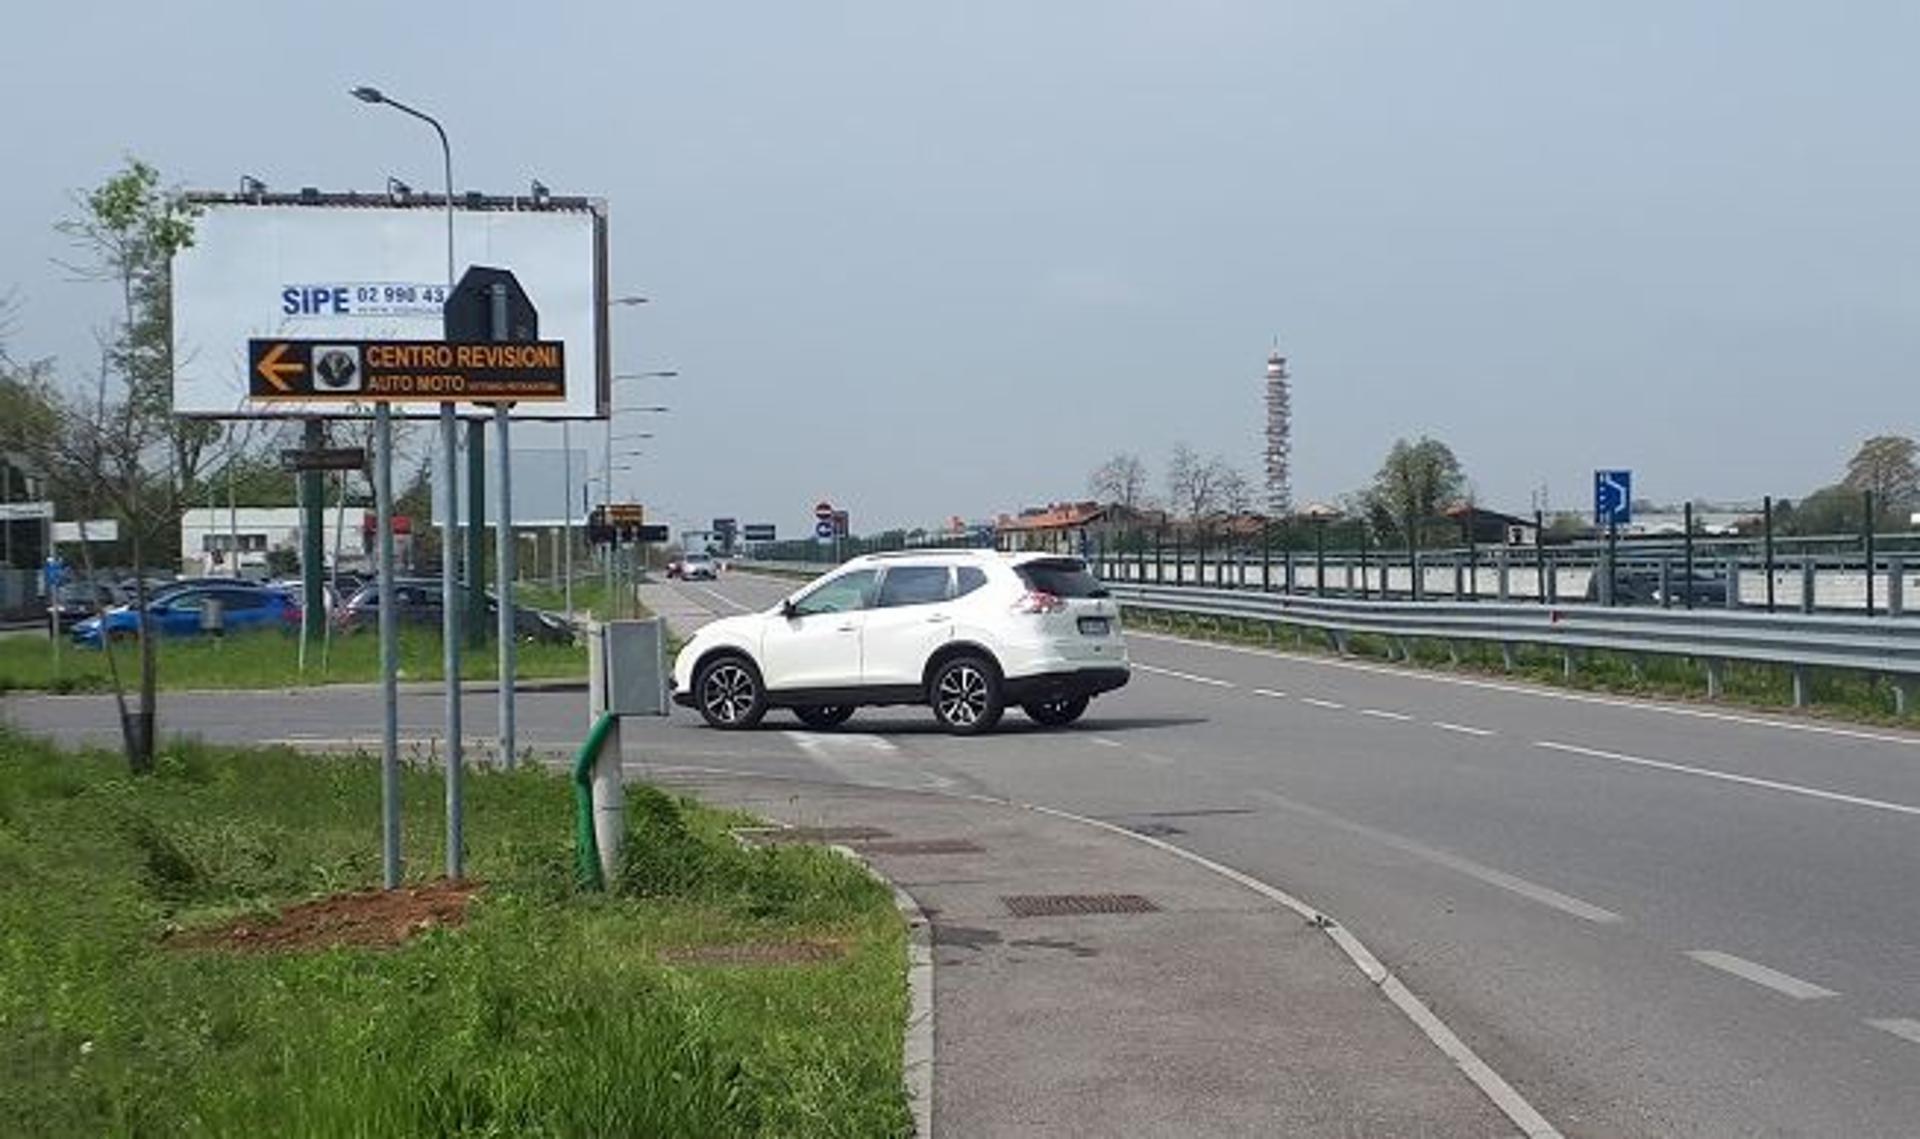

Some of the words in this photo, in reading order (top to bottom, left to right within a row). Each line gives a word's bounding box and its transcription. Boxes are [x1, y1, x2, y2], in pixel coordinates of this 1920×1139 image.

[282, 287, 350, 315] SIPE
[357, 287, 379, 303] 02
[366, 346, 453, 368] CENTRO
[457, 346, 559, 369] REVISIONI
[368, 375, 414, 391] AUTO
[416, 375, 465, 391] MOTO
